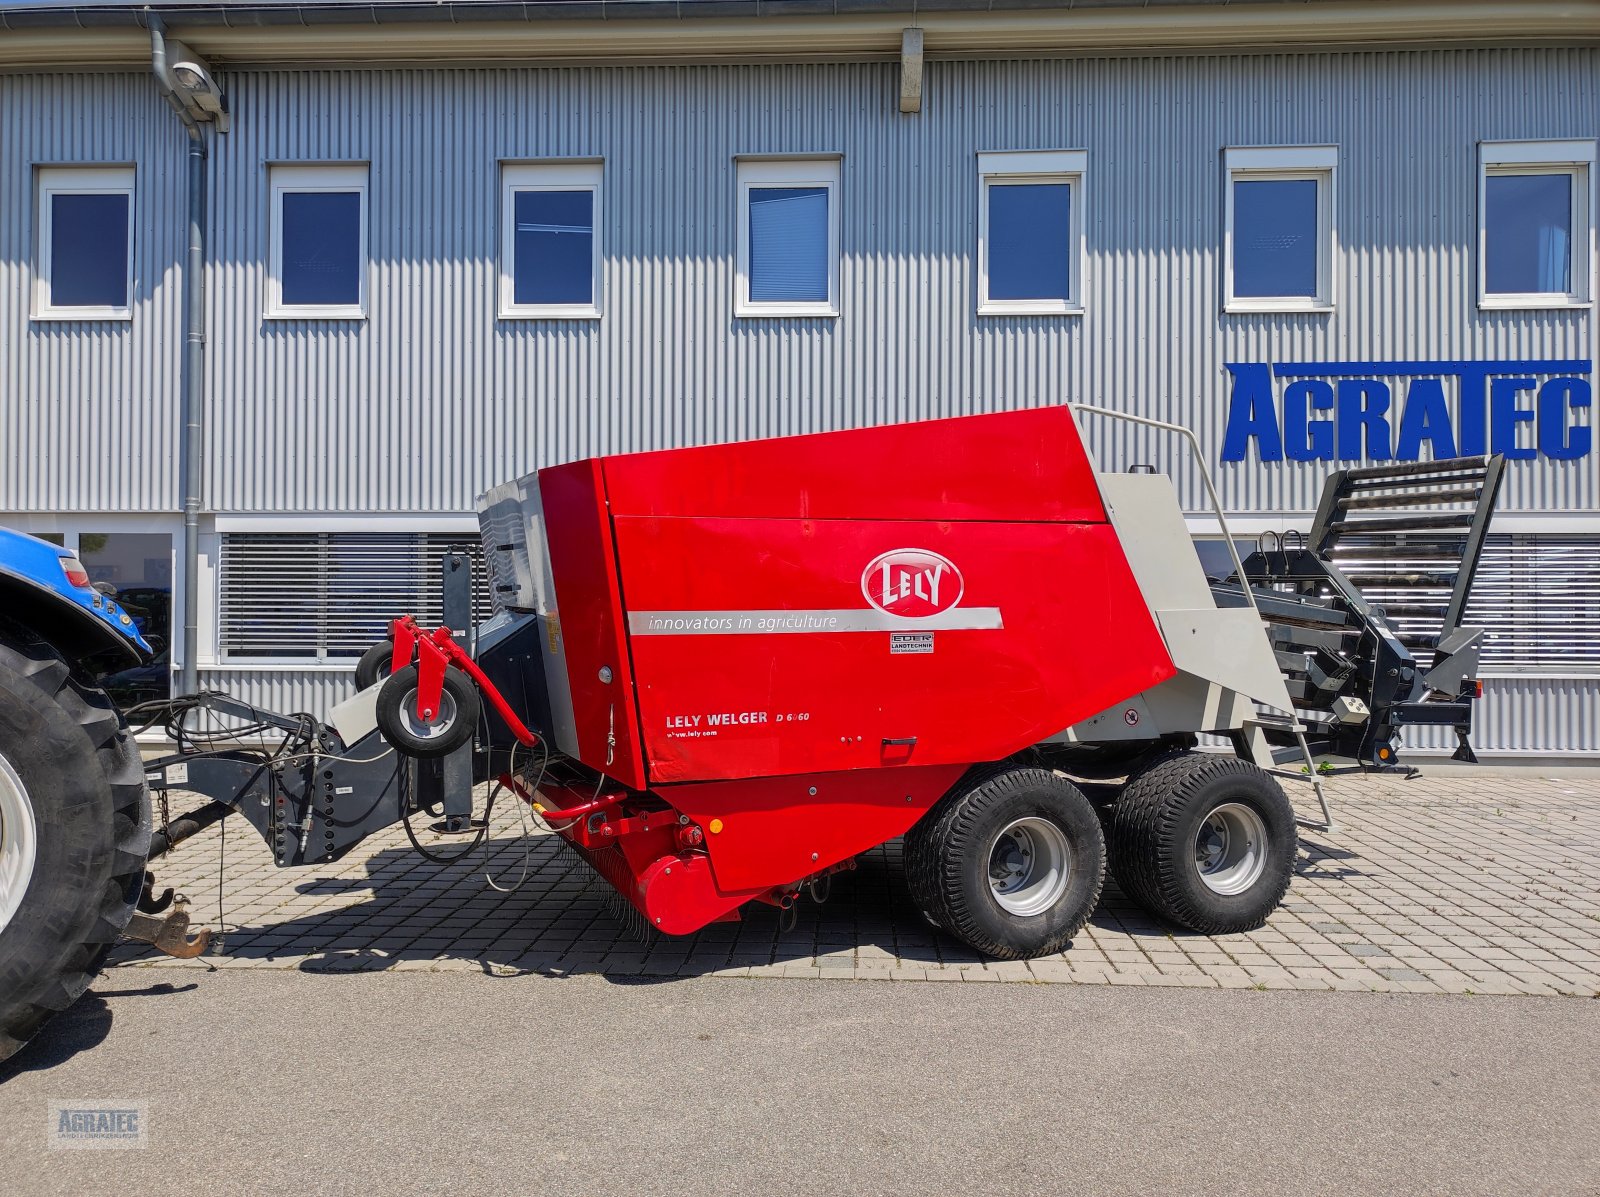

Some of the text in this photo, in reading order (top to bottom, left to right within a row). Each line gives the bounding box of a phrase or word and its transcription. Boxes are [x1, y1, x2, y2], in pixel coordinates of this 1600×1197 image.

[1220, 360, 1592, 462] AGRATEC
[882, 561, 943, 607] LELY
[649, 614, 837, 632] innovators in agriculture
[666, 714, 702, 728] LELY
[706, 711, 768, 726] WELGER
[776, 714, 784, 722] D
